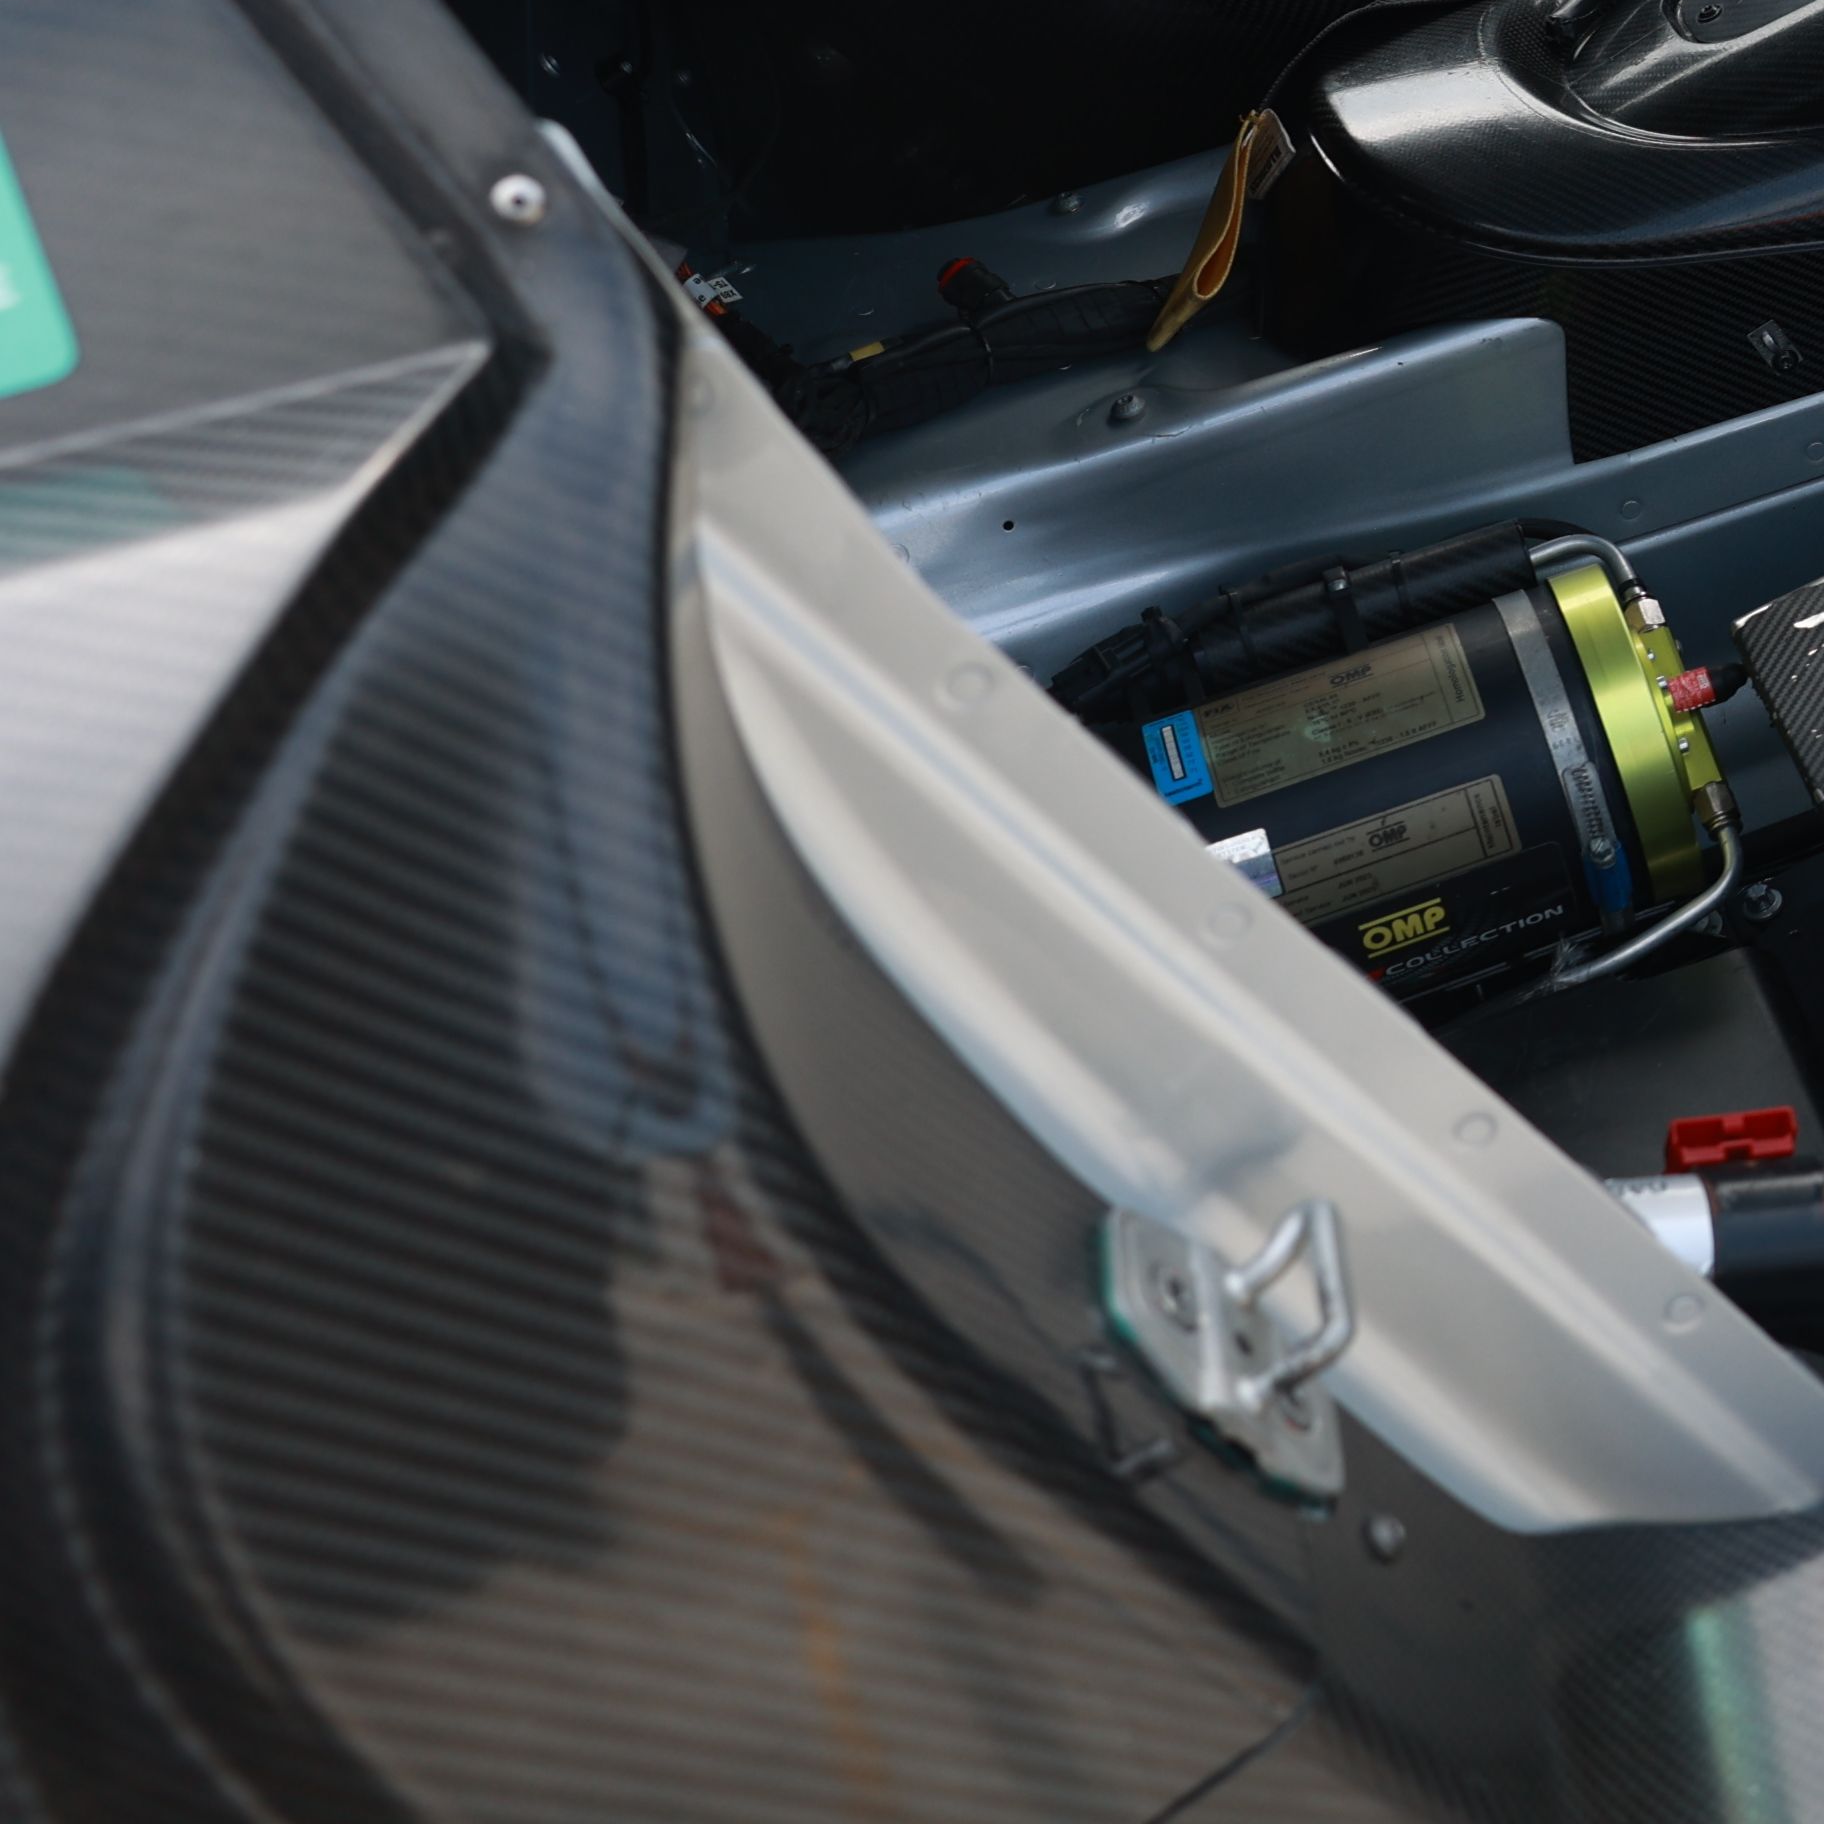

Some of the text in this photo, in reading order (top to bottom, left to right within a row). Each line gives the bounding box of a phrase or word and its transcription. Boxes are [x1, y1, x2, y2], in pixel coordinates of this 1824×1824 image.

[1329, 664, 1373, 686] OMP
[1368, 824, 1409, 849] OMP
[1362, 905, 1446, 951] OMP
[1385, 904, 1565, 976] COLLECTION
